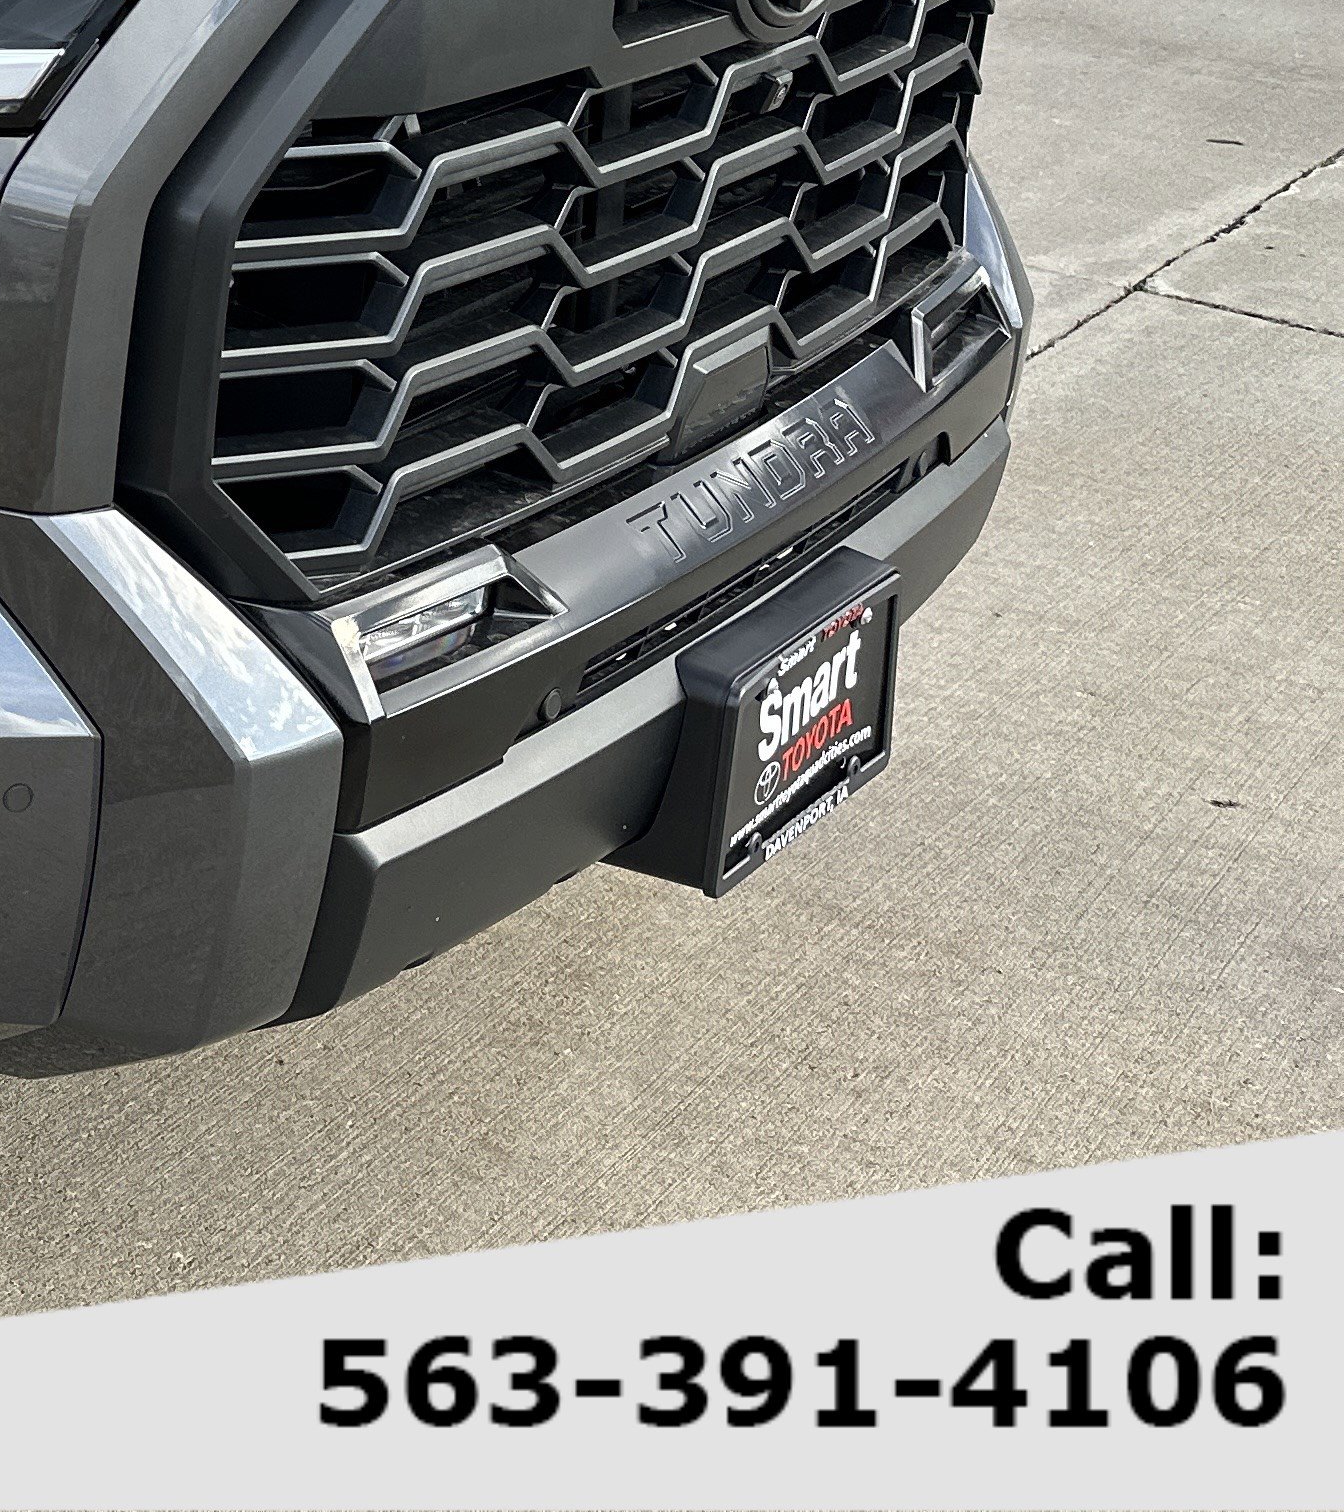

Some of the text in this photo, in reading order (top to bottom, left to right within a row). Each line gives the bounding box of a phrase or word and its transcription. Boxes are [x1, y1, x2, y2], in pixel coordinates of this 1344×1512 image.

[625, 397, 875, 563] TUNDRA
[777, 602, 865, 677] Smart TOYOTA
[758, 630, 861, 762] Smart
[780, 699, 853, 781] TOYOTA
[765, 785, 849, 861] DAVENPORT, IA
